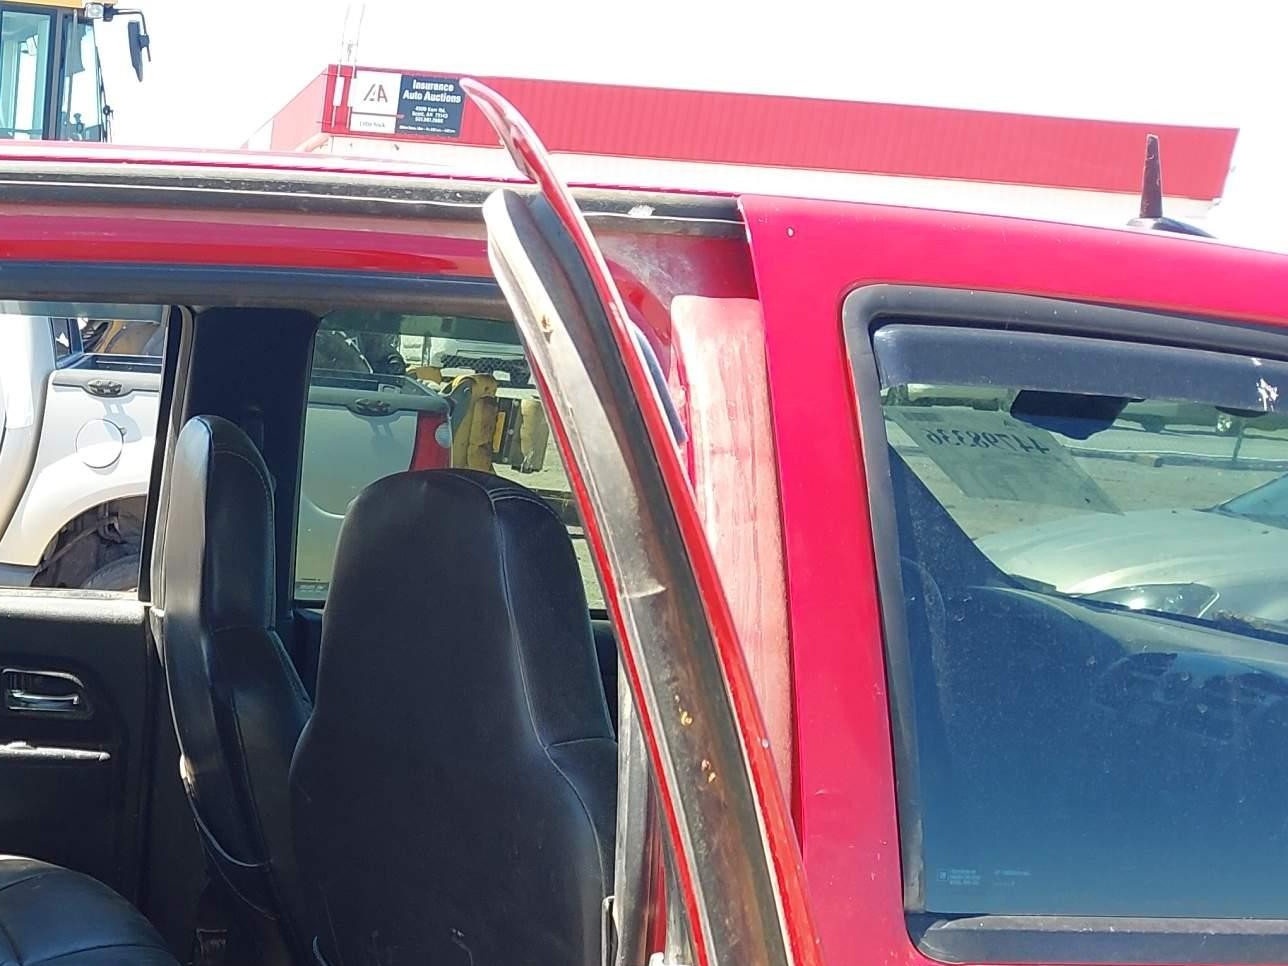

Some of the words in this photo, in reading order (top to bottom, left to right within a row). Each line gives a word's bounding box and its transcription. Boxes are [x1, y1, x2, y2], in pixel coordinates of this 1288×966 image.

[413, 80, 454, 92] Insurance
[402, 89, 423, 100] Auto
[424, 91, 461, 103] Auctions
